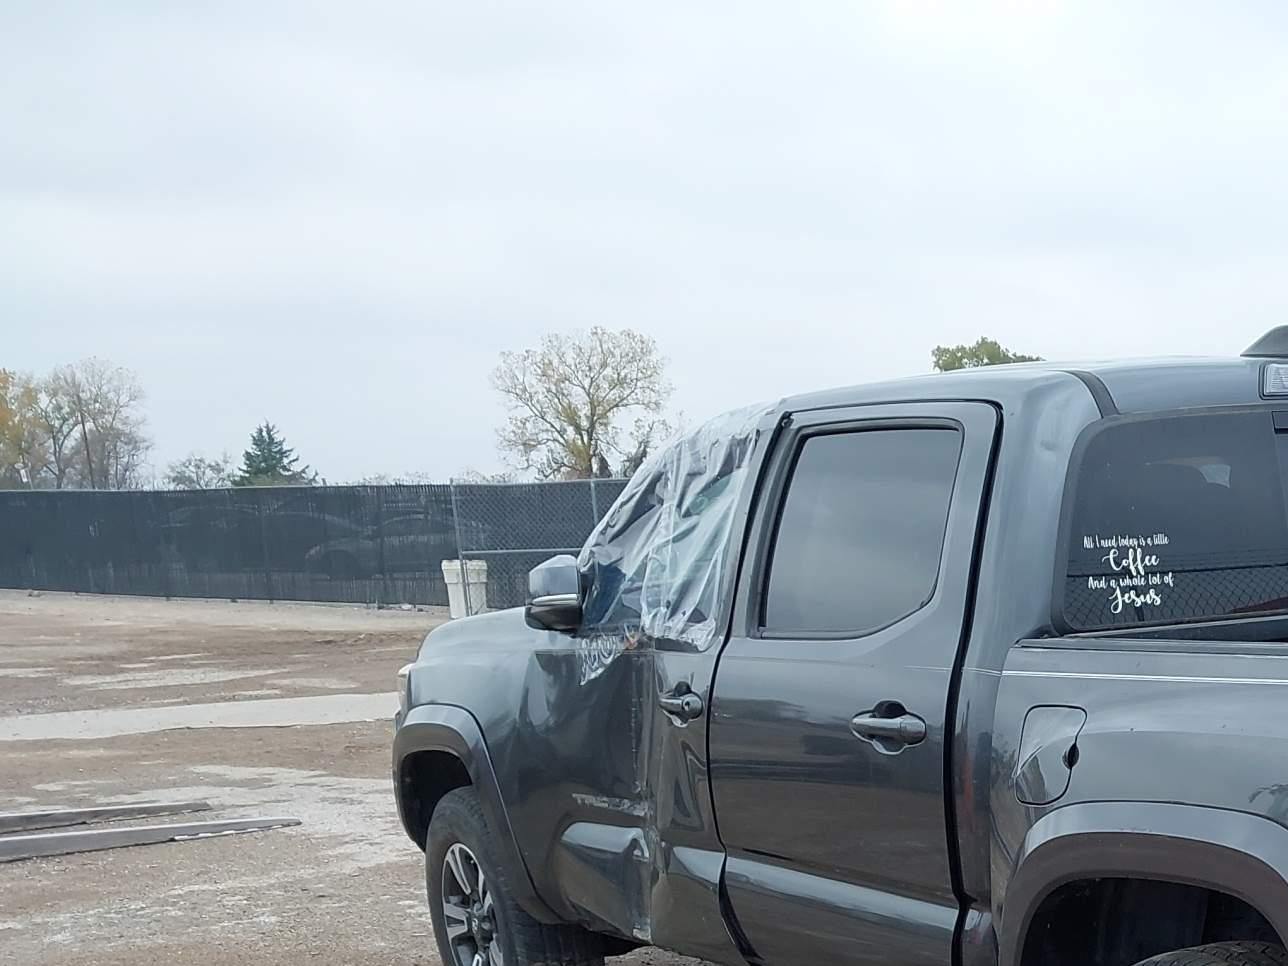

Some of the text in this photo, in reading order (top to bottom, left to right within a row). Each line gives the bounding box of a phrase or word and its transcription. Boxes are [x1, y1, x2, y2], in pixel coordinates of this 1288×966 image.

[1083, 535, 1094, 549] All
[1101, 535, 1118, 548] need
[1118, 534, 1138, 549] today
[1139, 535, 1146, 547] is
[1102, 548, 1160, 576] Coffee
[1088, 571, 1175, 590] And a whole lot of
[1109, 586, 1162, 614] Jesus
